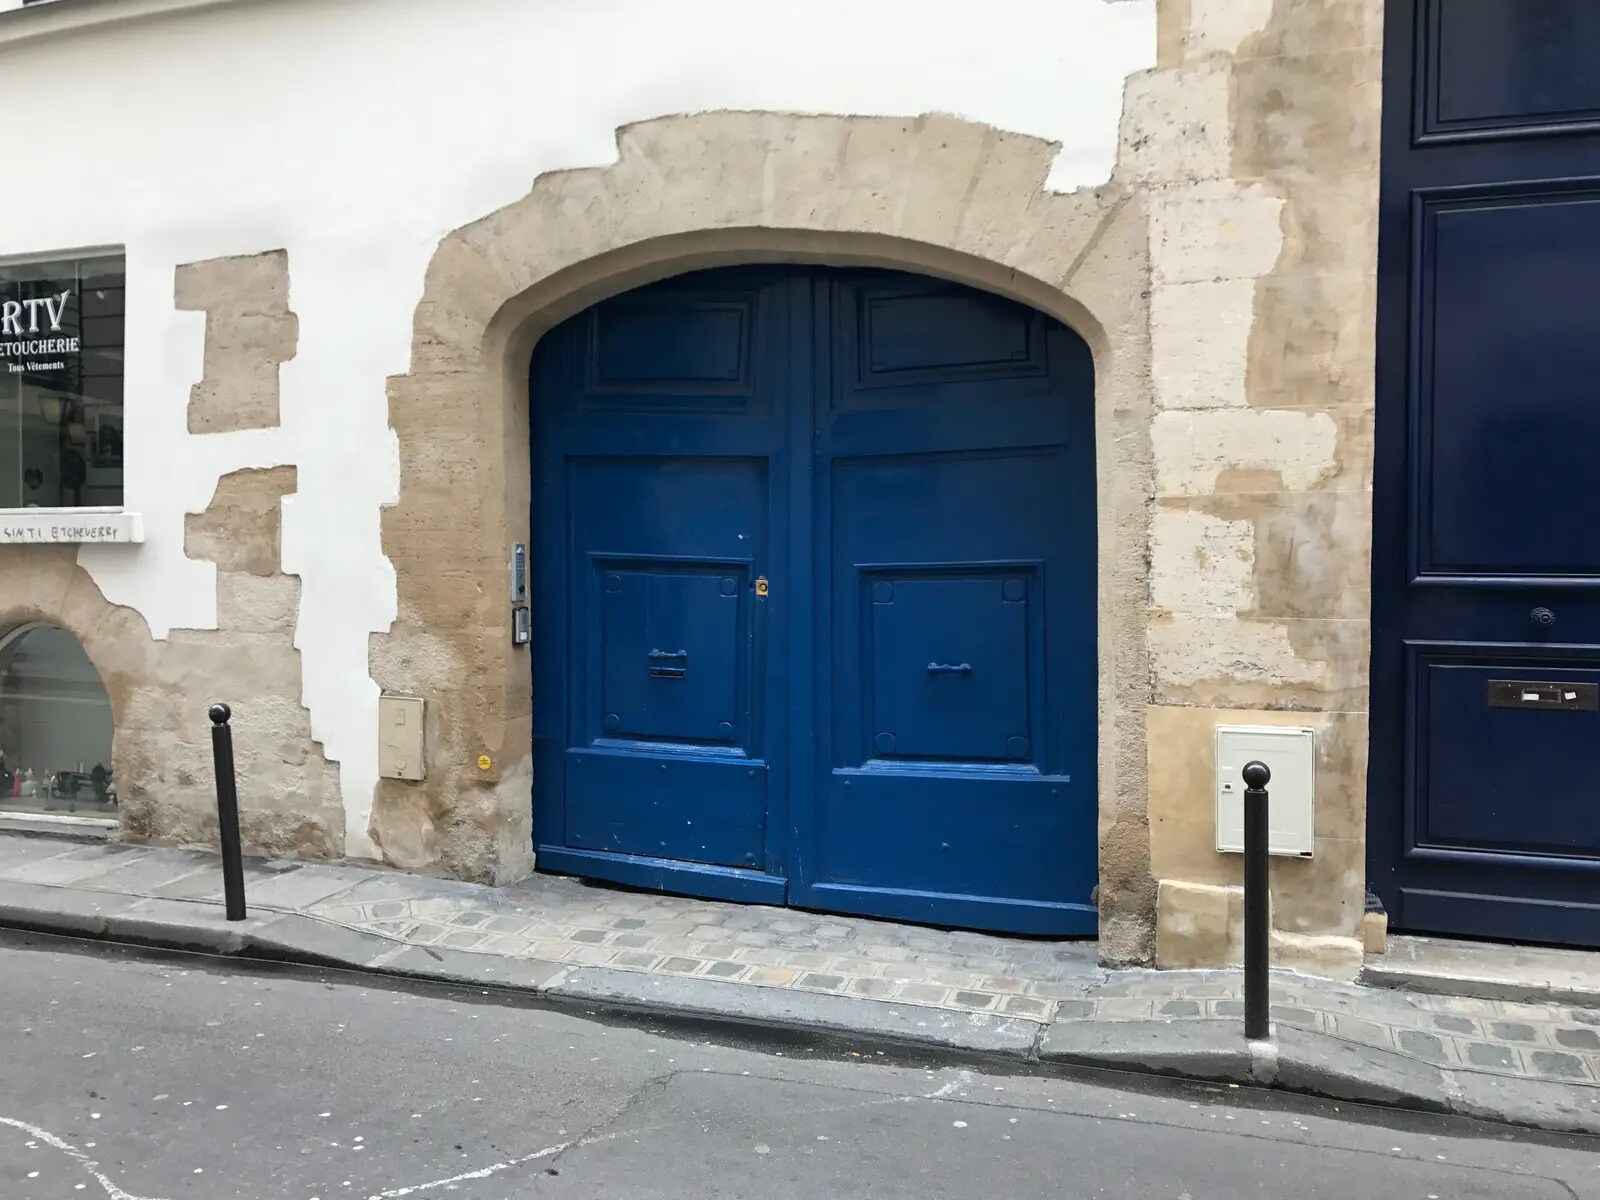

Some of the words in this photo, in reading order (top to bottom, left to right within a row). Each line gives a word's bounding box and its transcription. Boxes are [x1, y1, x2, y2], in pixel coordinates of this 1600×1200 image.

[1, 289, 71, 336] RTV
[7, 363, 25, 373] Tous
[27, 361, 65, 372] Vêtements
[51, 526, 119, 540] ETCHEVERRY
